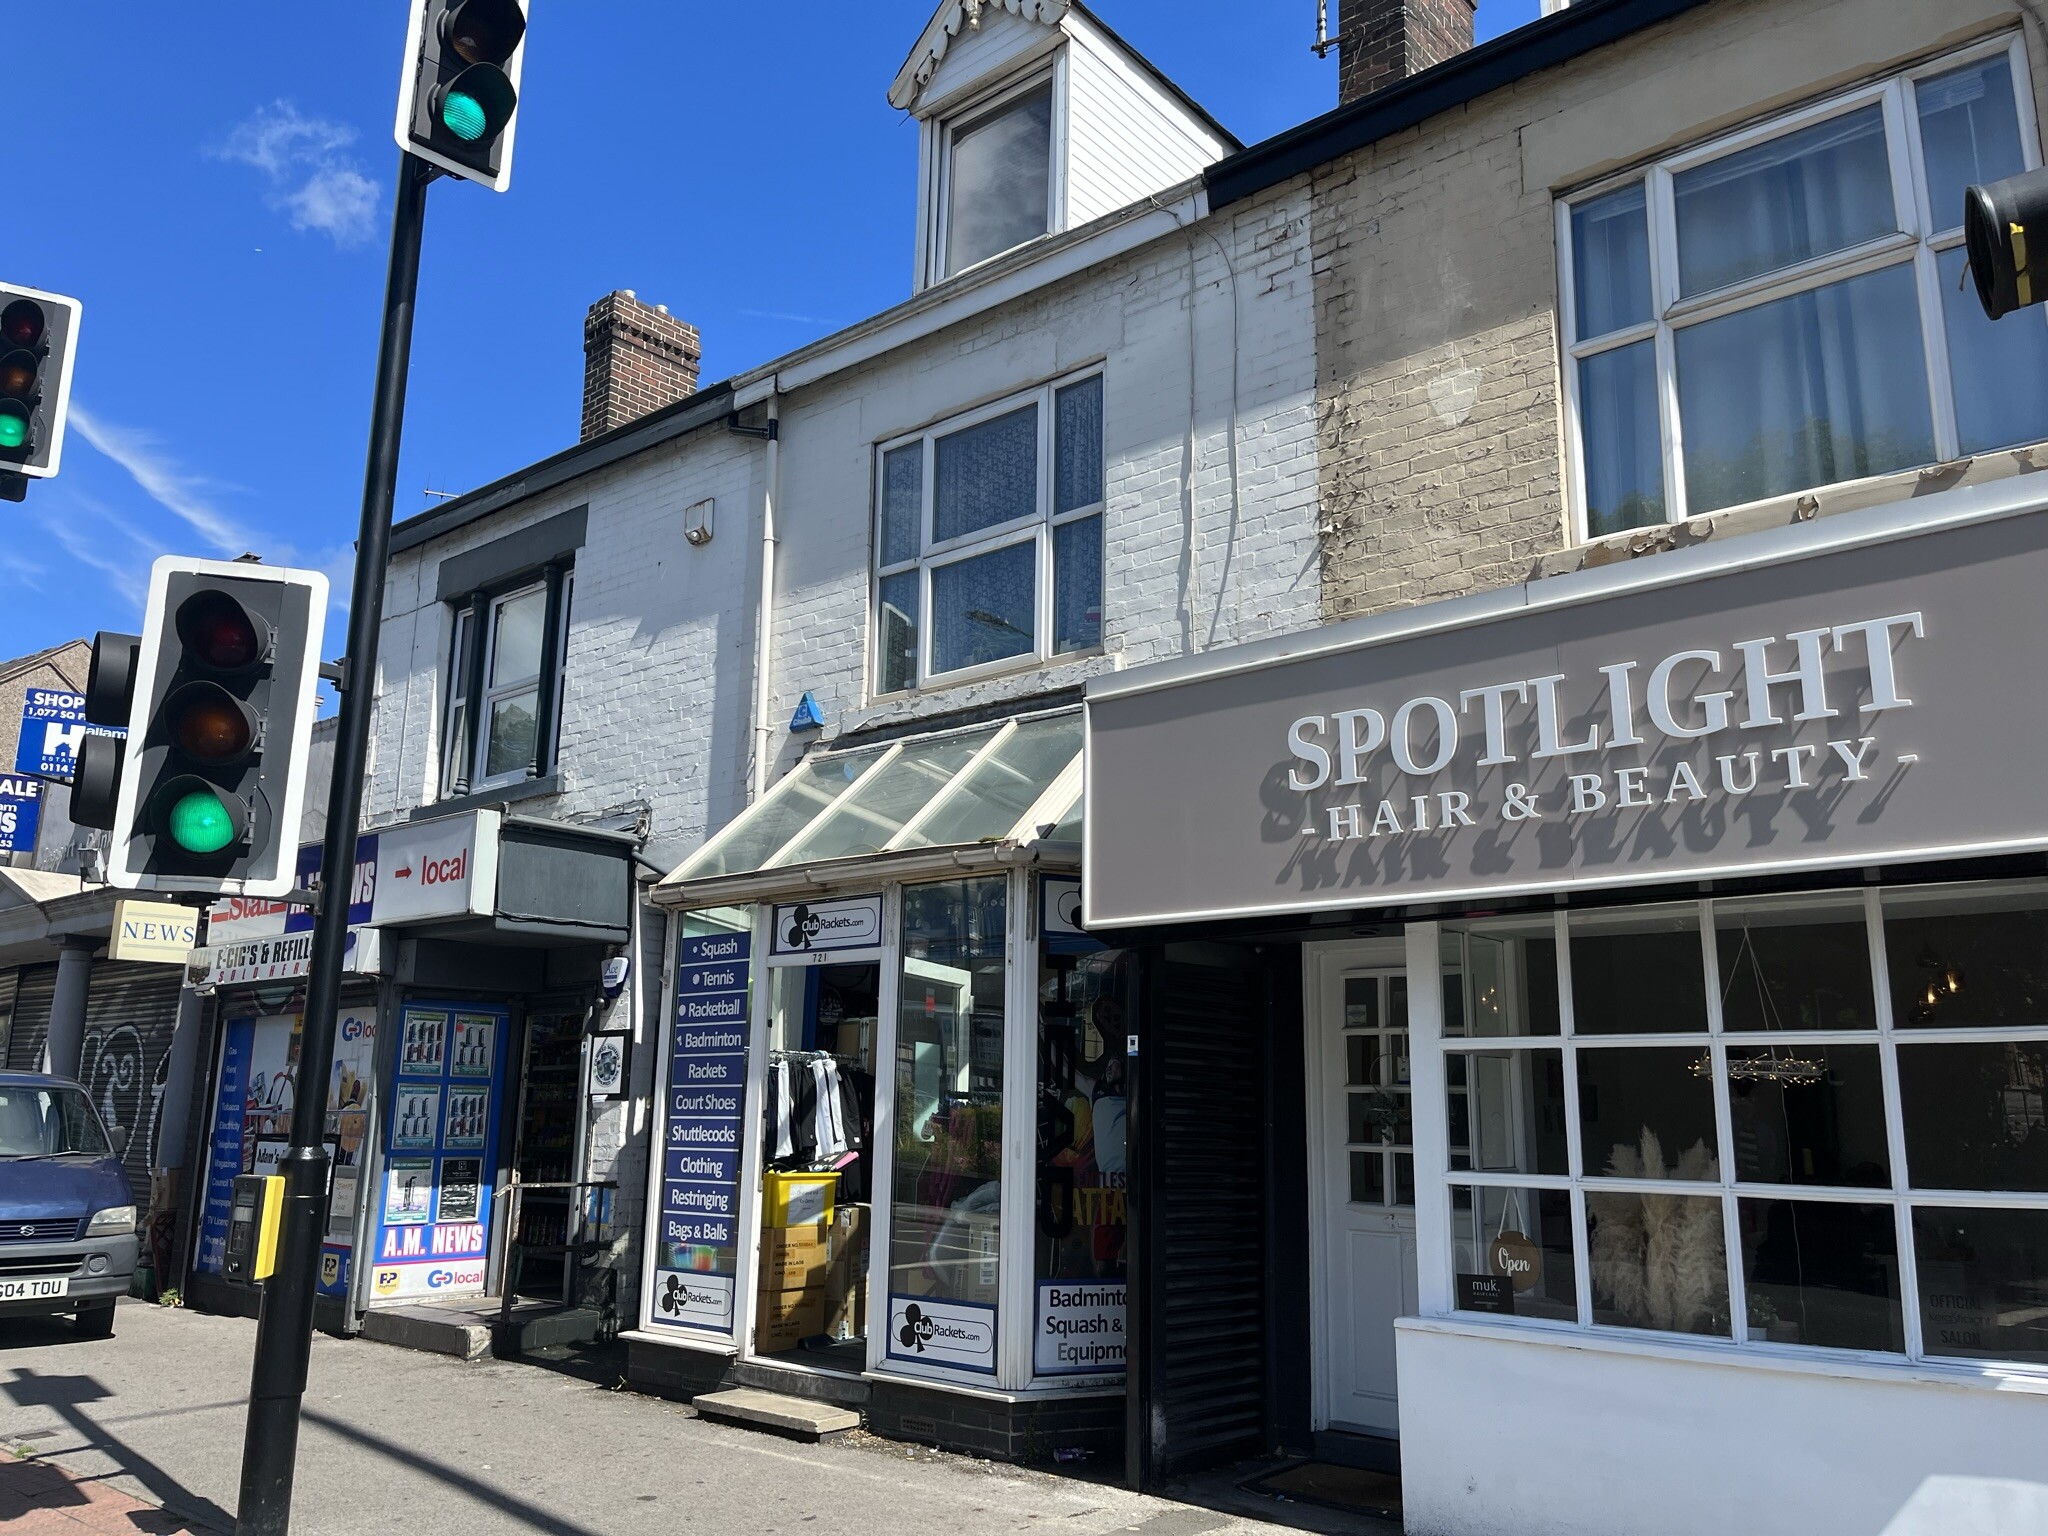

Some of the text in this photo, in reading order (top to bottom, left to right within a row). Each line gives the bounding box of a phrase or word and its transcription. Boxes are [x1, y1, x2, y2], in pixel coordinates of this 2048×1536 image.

[34, 692, 86, 709] SHOP
[1287, 611, 1924, 793] SPOTLIGHT
[28, 707, 57, 718] 1,077
[60, 710, 75, 720] SQ
[41, 763, 69, 773] 0114
[1501, 782, 1543, 821] &
[1568, 737, 1876, 814] BEAUTY
[421, 848, 466, 886] local
[123, 921, 195, 943] NEWS
[260, 942, 270, 965] &
[272, 938, 312, 963] REFILL
[701, 938, 738, 957] Squash
[812, 953, 827, 963] 721
[702, 970, 735, 986] Tennis
[688, 999, 740, 1018] Racketball
[685, 1032, 742, 1048] Badminton
[688, 1063, 727, 1079] Rackets
[221, 1103, 239, 1112] Tobacco
[675, 1094, 736, 1111] Court Shoes
[672, 1125, 736, 1143] Shuttlecocks
[257, 1147, 280, 1164] Adam's
[680, 1157, 724, 1178] Clothing
[211, 1177, 229, 1187] Council
[209, 1197, 231, 1208] Newspape
[672, 1189, 729, 1211] Restringing
[1073, 1188, 1127, 1226] ATTA
[214, 1217, 229, 1227] Licenc
[668, 1221, 728, 1242] Bags & Balls
[383, 1224, 484, 1257] A.M. NEWS
[1498, 1246, 1530, 1277] Open
[454, 1270, 484, 1284] local
[31, 1280, 61, 1296] TOU
[1049, 1288, 1127, 1308] Badmint
[1929, 1294, 1984, 1310] OFFICIAL
[1045, 1315, 1123, 1339] Squash &
[1940, 1329, 1981, 1345] SALON
[1058, 1342, 1127, 1365] Equipm
